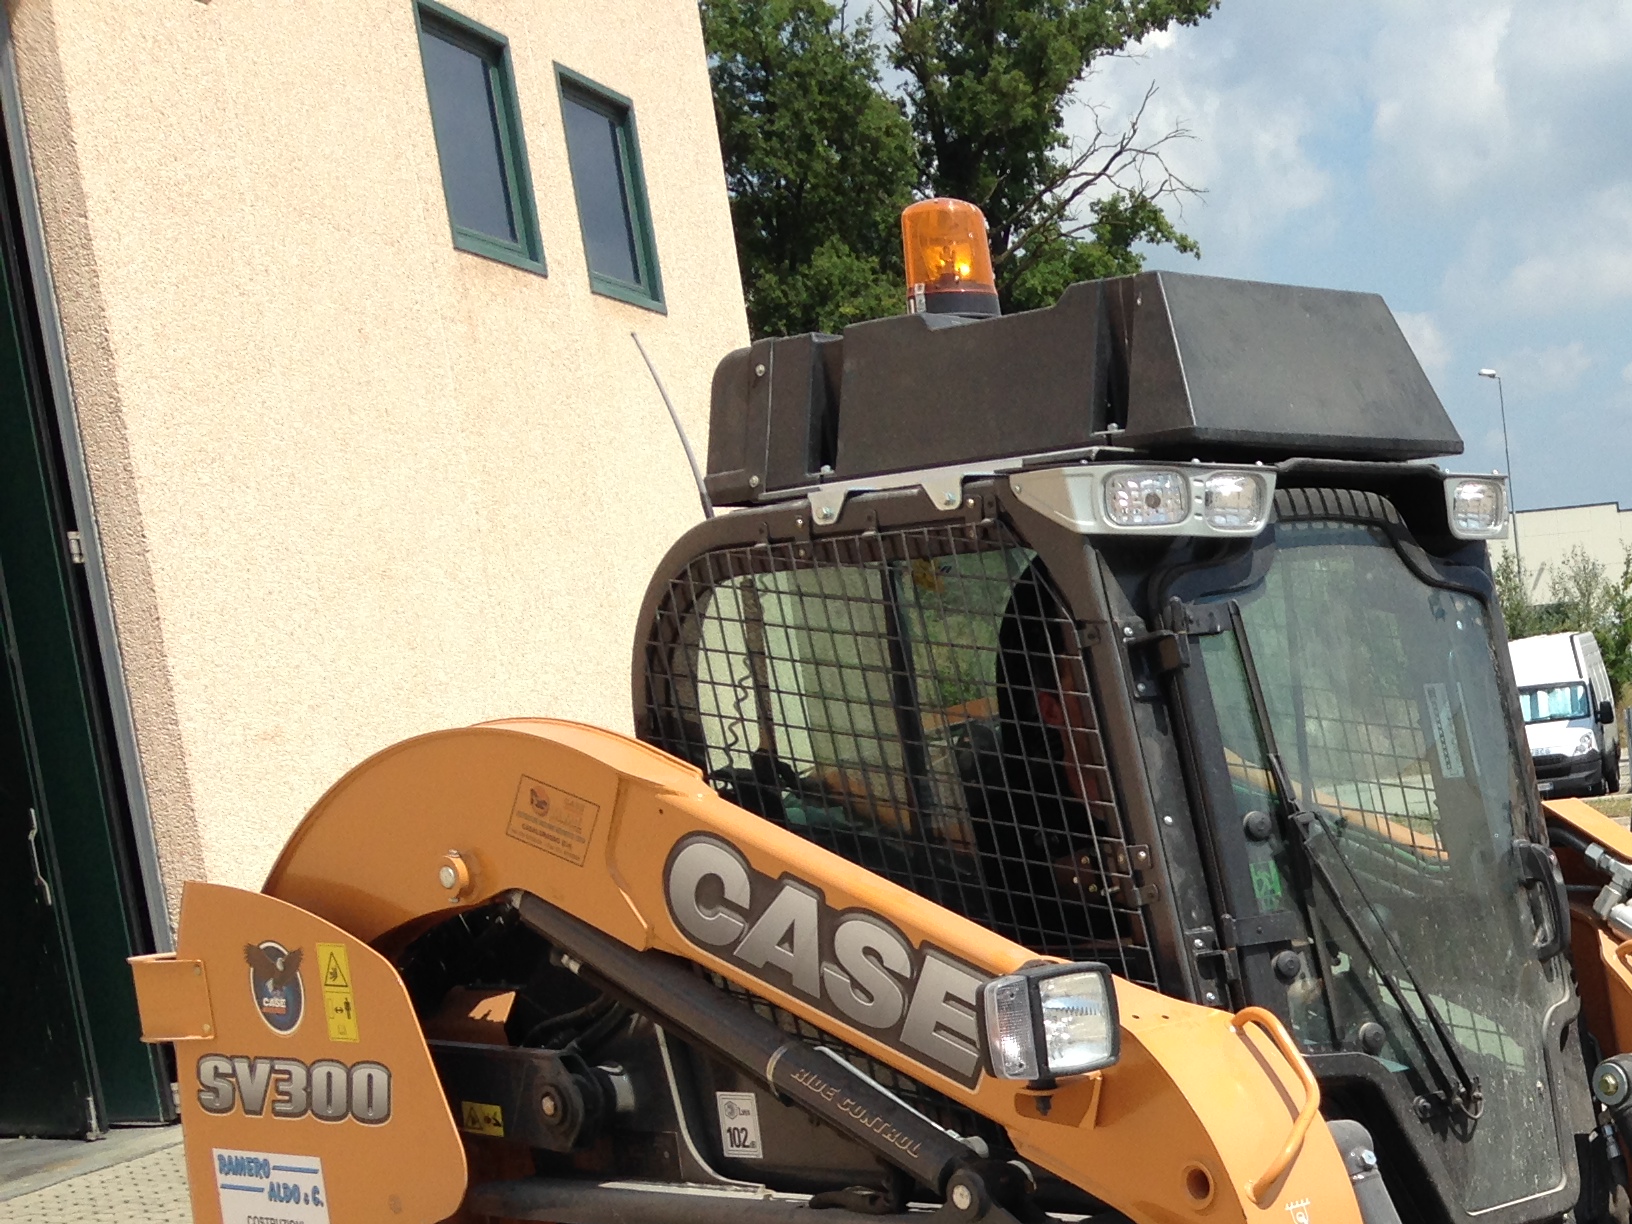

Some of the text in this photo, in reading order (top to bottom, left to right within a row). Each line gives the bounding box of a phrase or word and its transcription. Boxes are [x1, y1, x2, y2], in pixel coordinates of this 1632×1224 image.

[666, 836, 982, 1084] CASE
[198, 1053, 392, 1126] SV300
[726, 1126, 750, 1148] 102
